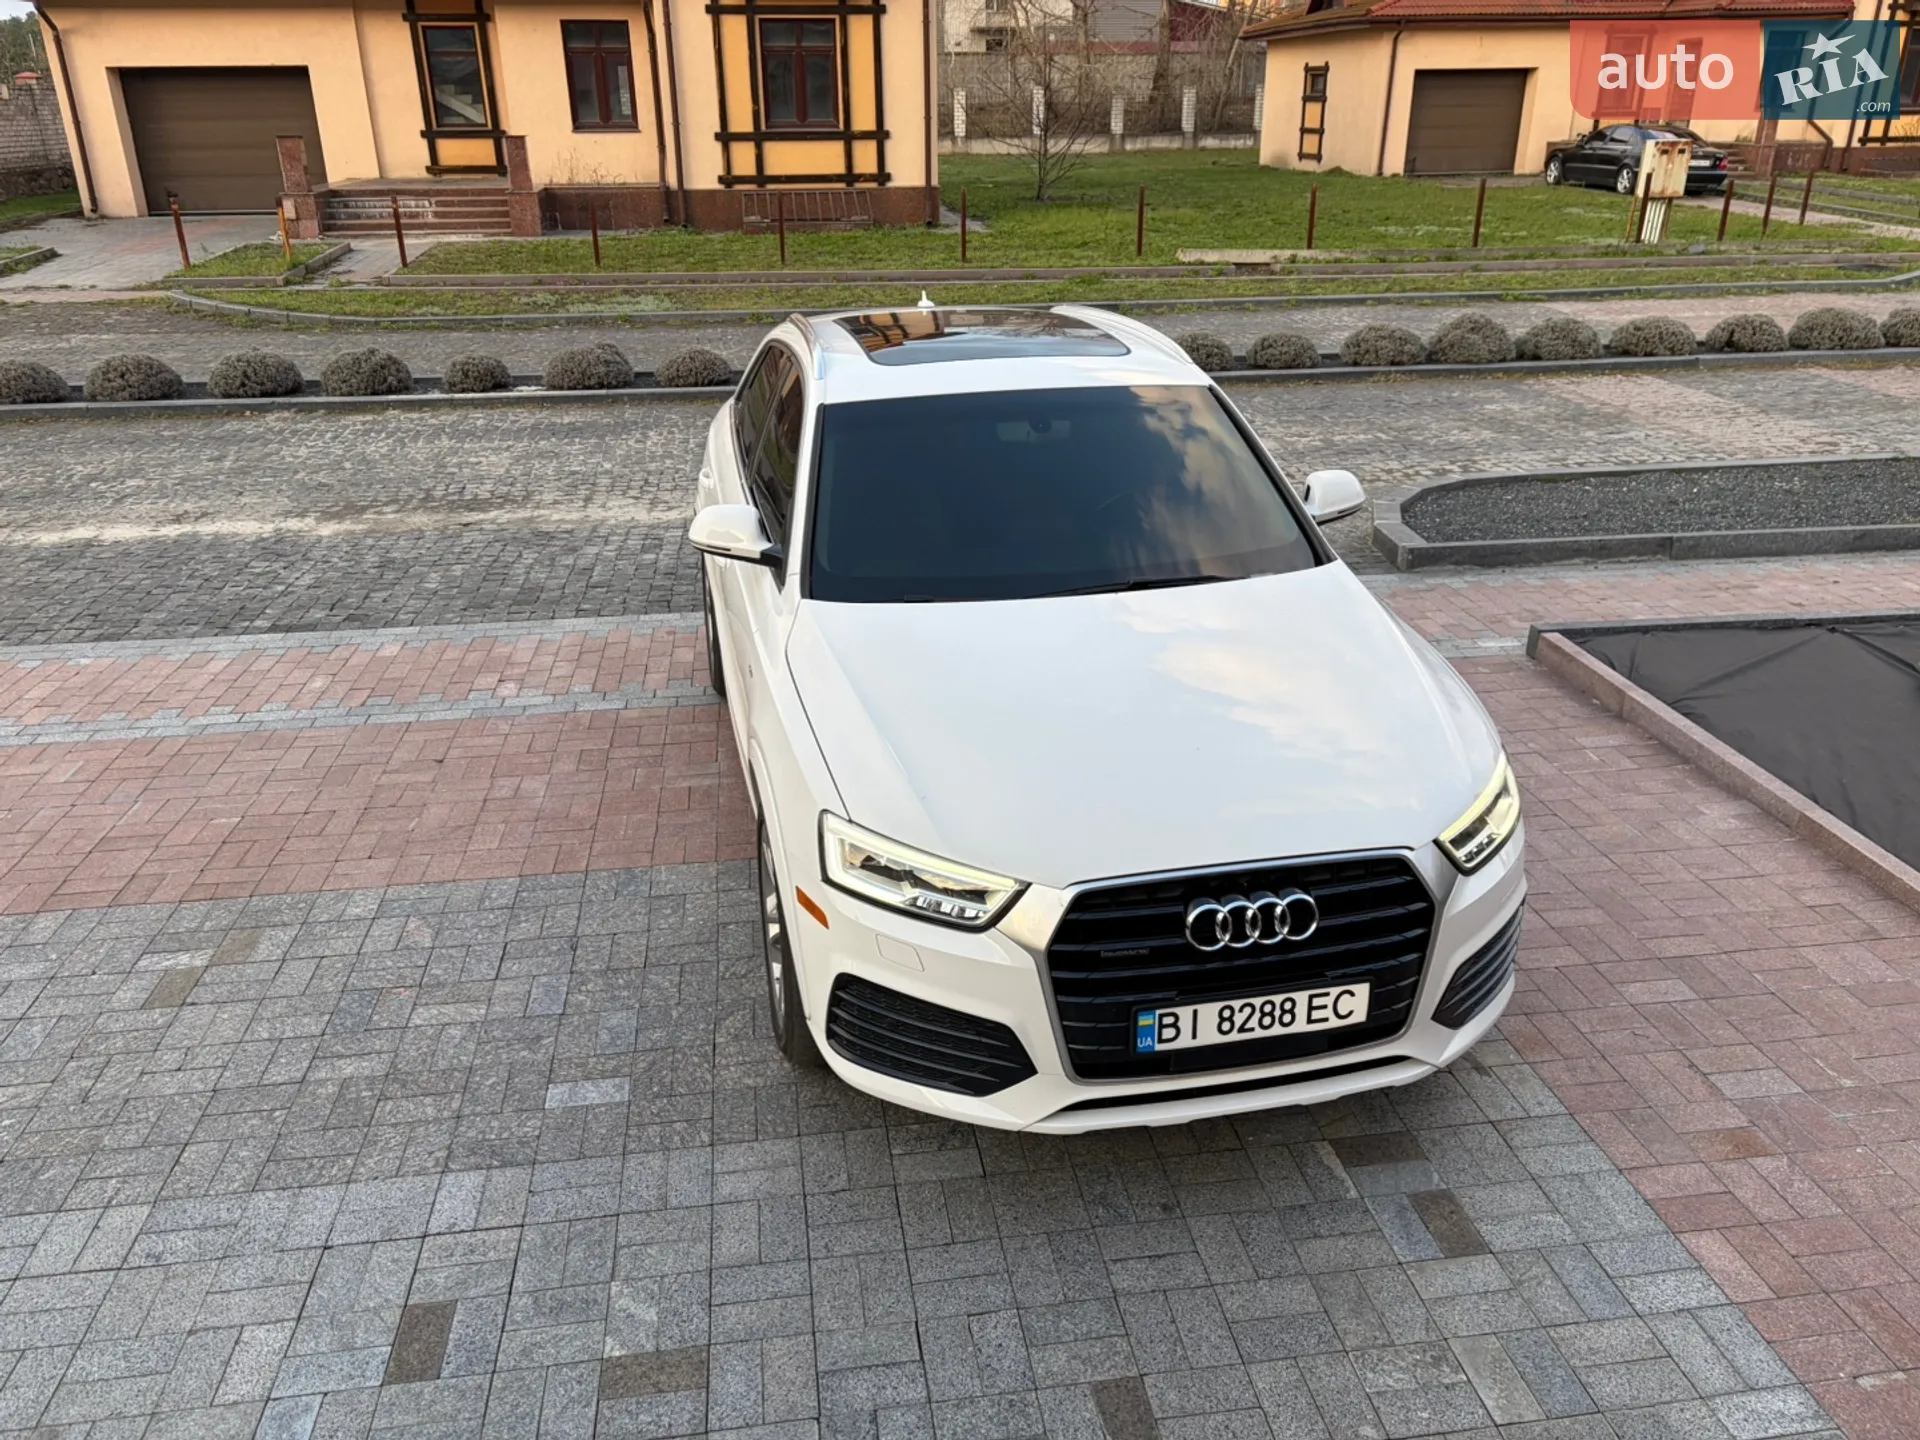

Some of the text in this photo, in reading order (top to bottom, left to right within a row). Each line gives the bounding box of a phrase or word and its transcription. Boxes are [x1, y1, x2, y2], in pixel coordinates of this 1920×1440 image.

[1157, 989, 1356, 1044] BI 8288 EC
[1137, 1036, 1153, 1048] UA
